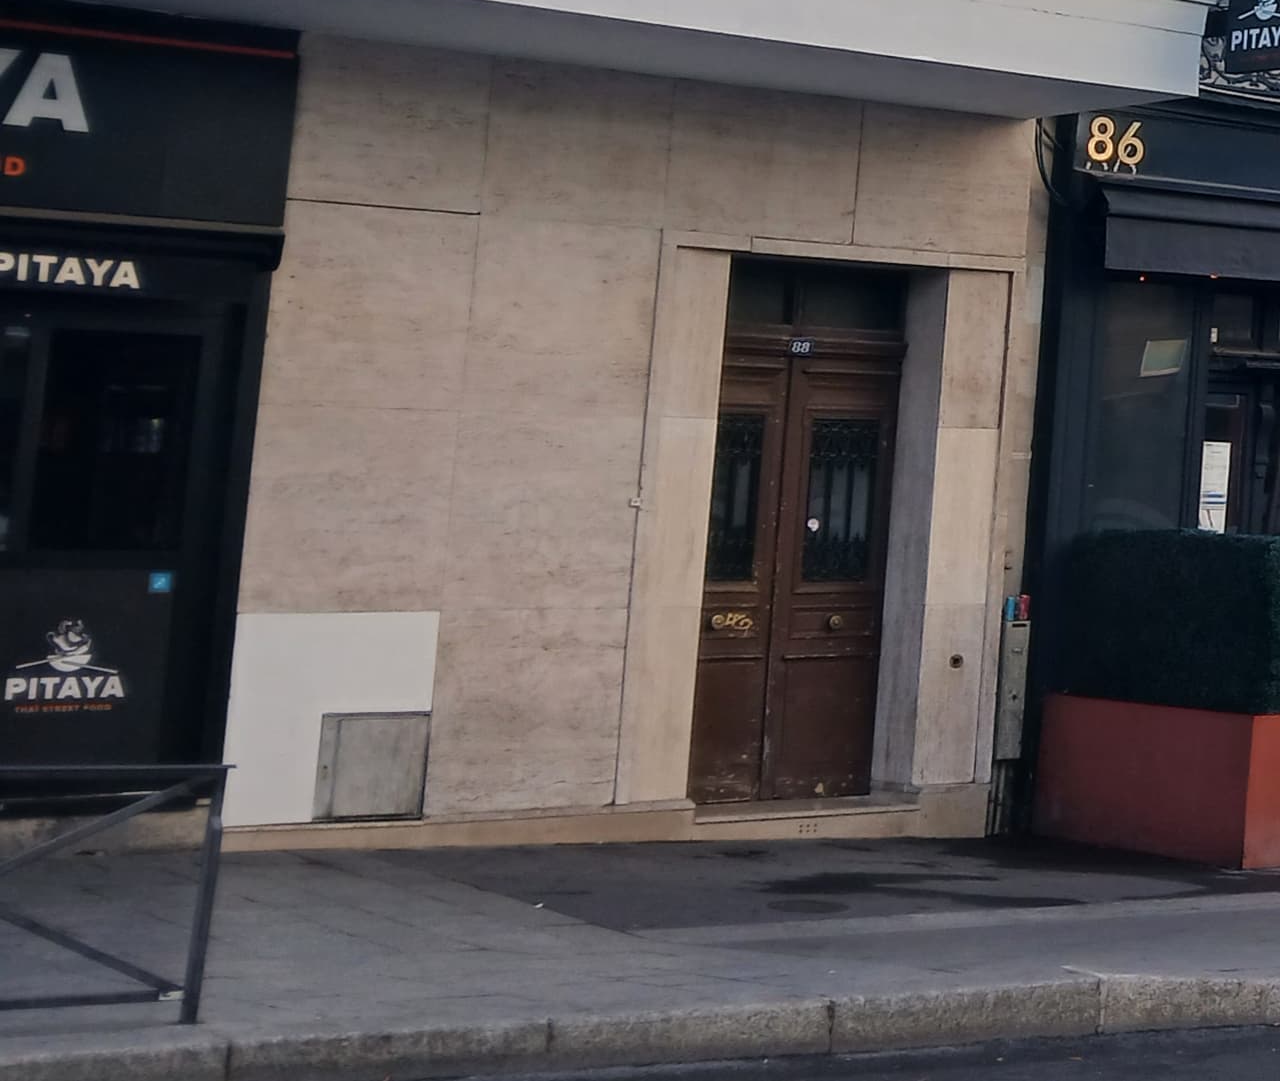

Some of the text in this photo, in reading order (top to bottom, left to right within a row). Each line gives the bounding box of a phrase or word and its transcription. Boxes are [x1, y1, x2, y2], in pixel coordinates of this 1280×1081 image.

[1087, 116, 1145, 165] 86
[0, 251, 141, 289] PITAYA
[791, 342, 810, 353] 88
[4, 675, 125, 701] PITAYA
